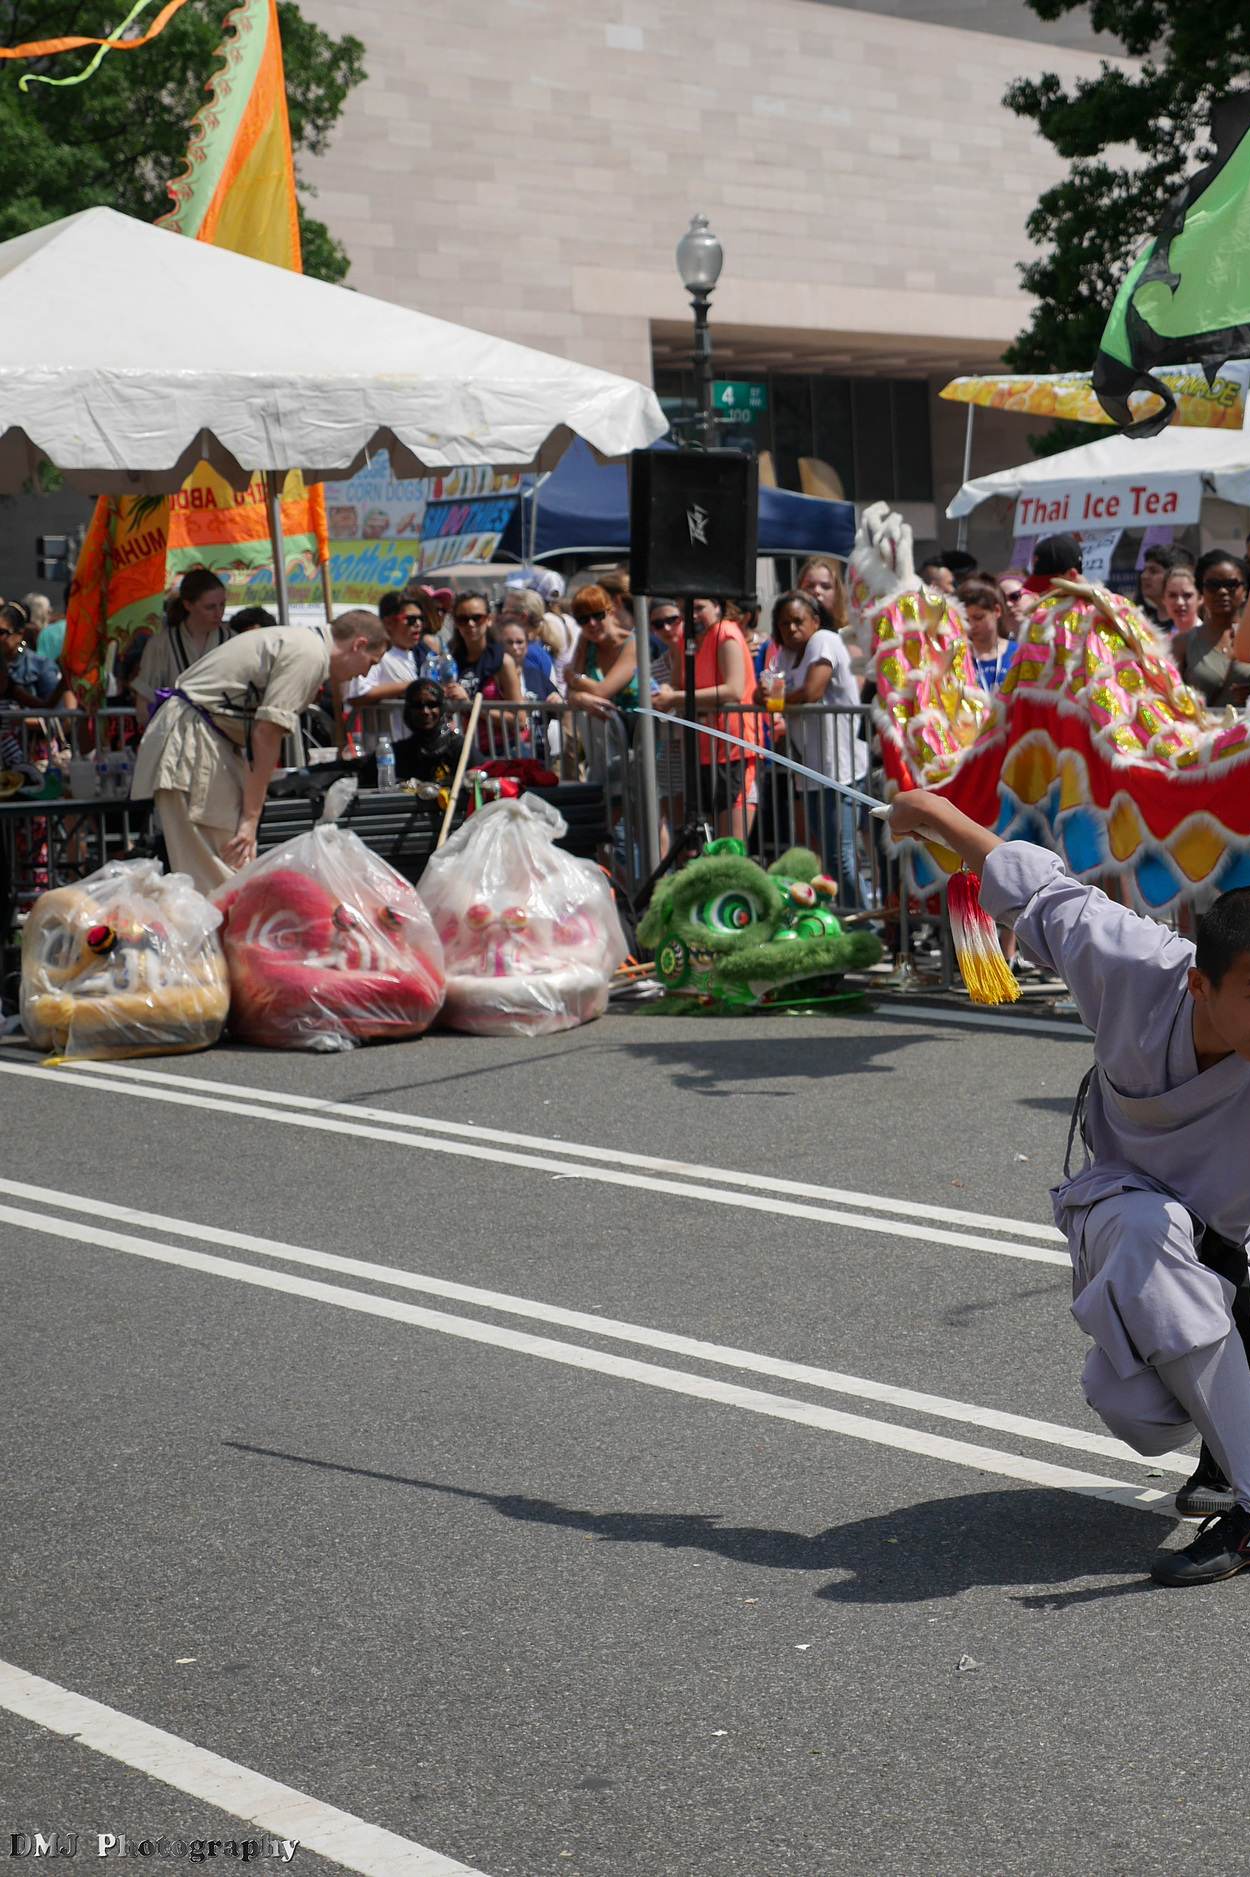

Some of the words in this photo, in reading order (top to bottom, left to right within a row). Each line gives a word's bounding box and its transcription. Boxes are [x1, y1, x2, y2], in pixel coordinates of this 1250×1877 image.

[721, 385, 735, 406] 4
[749, 387, 761, 396] ST
[749, 398, 762, 407] NW
[728, 408, 752, 423] 100
[346, 481, 382, 502] CORN
[386, 481, 423, 502] DOGS
[1019, 494, 1072, 526] Thai
[1082, 492, 1120, 520] Ice
[1129, 486, 1178, 516] Tea
